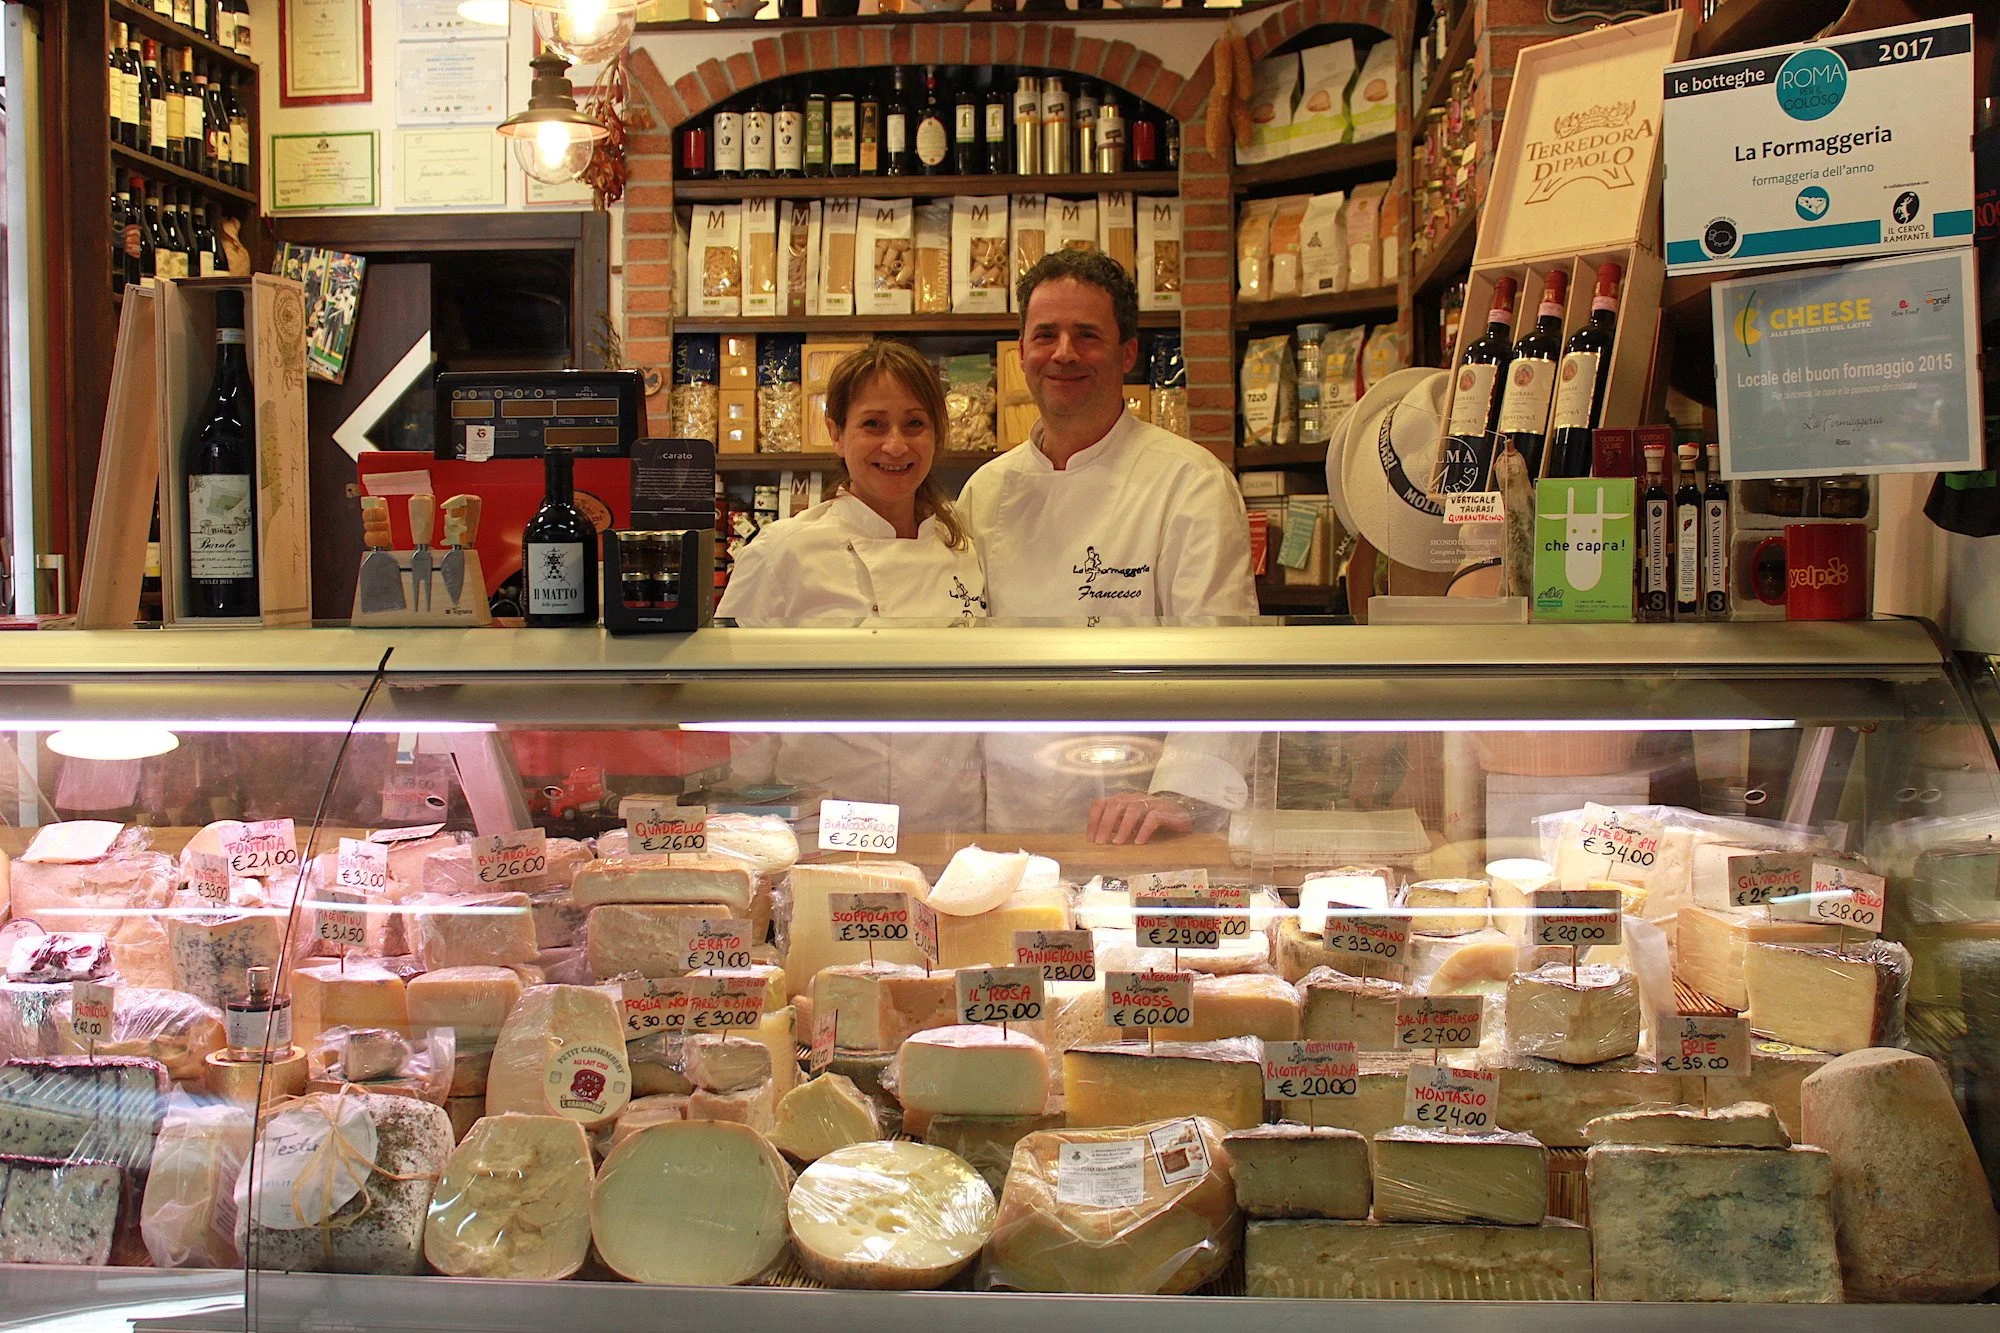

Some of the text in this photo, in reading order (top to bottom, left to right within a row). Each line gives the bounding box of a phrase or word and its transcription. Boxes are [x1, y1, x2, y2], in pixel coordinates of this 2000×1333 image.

[1878, 36, 1934, 63] 2017
[1674, 68, 1765, 95] le botteghe
[1782, 62, 1844, 91] ROMA
[1784, 93, 1839, 111] GOLOSO
[1526, 119, 1653, 162] TERREDORA
[1735, 125, 1892, 162] La Formaggeria
[1752, 162, 1875, 187] formaggeria dell'anno
[1884, 232, 1930, 243] RAMPANTE
[1898, 224, 1926, 234] CERVO
[1769, 298, 1872, 330] CHEESE
[1846, 321, 1872, 330] LATTE
[1737, 353, 1953, 388] Locale del buon formaggio 2015
[1801, 412, 1884, 432] La Formaggeria
[1451, 495, 1496, 504] VERTICALE
[196, 537, 236, 552] Barolo
[1545, 538, 1626, 555] che capra!
[1653, 520, 1661, 588] ACETOMODENA
[1713, 520, 1721, 588] ACETOMODENA
[1073, 565, 1083, 574] La
[1789, 564, 1827, 589] yelp
[542, 588, 577, 600] MATTO
[1078, 585, 1142, 600] Francesco
[263, 820, 283, 830] DOP
[636, 821, 704, 839] QUADRELLO
[224, 837, 286, 854] FONTINA
[832, 910, 907, 923] SCOPPOLATO
[1325, 920, 1405, 942] SAN TOSCANO
[689, 937, 741, 951] CERATO
[1017, 948, 1094, 964] PANNERONE
[969, 986, 1032, 1002] IL ROSA
[1112, 991, 1173, 1008] BAGOSS
[624, 999, 661, 1014] FOGLIA
[1395, 1015, 1428, 1026] SALVA
[1681, 1040, 1716, 1056] BRIE
[557, 1046, 624, 1074] PETIT CAMEMBERT
[596, 1062, 609, 1070] CRU
[1314, 1063, 1357, 1078] SARDA
[1415, 1087, 1487, 1106] MONTASIO
